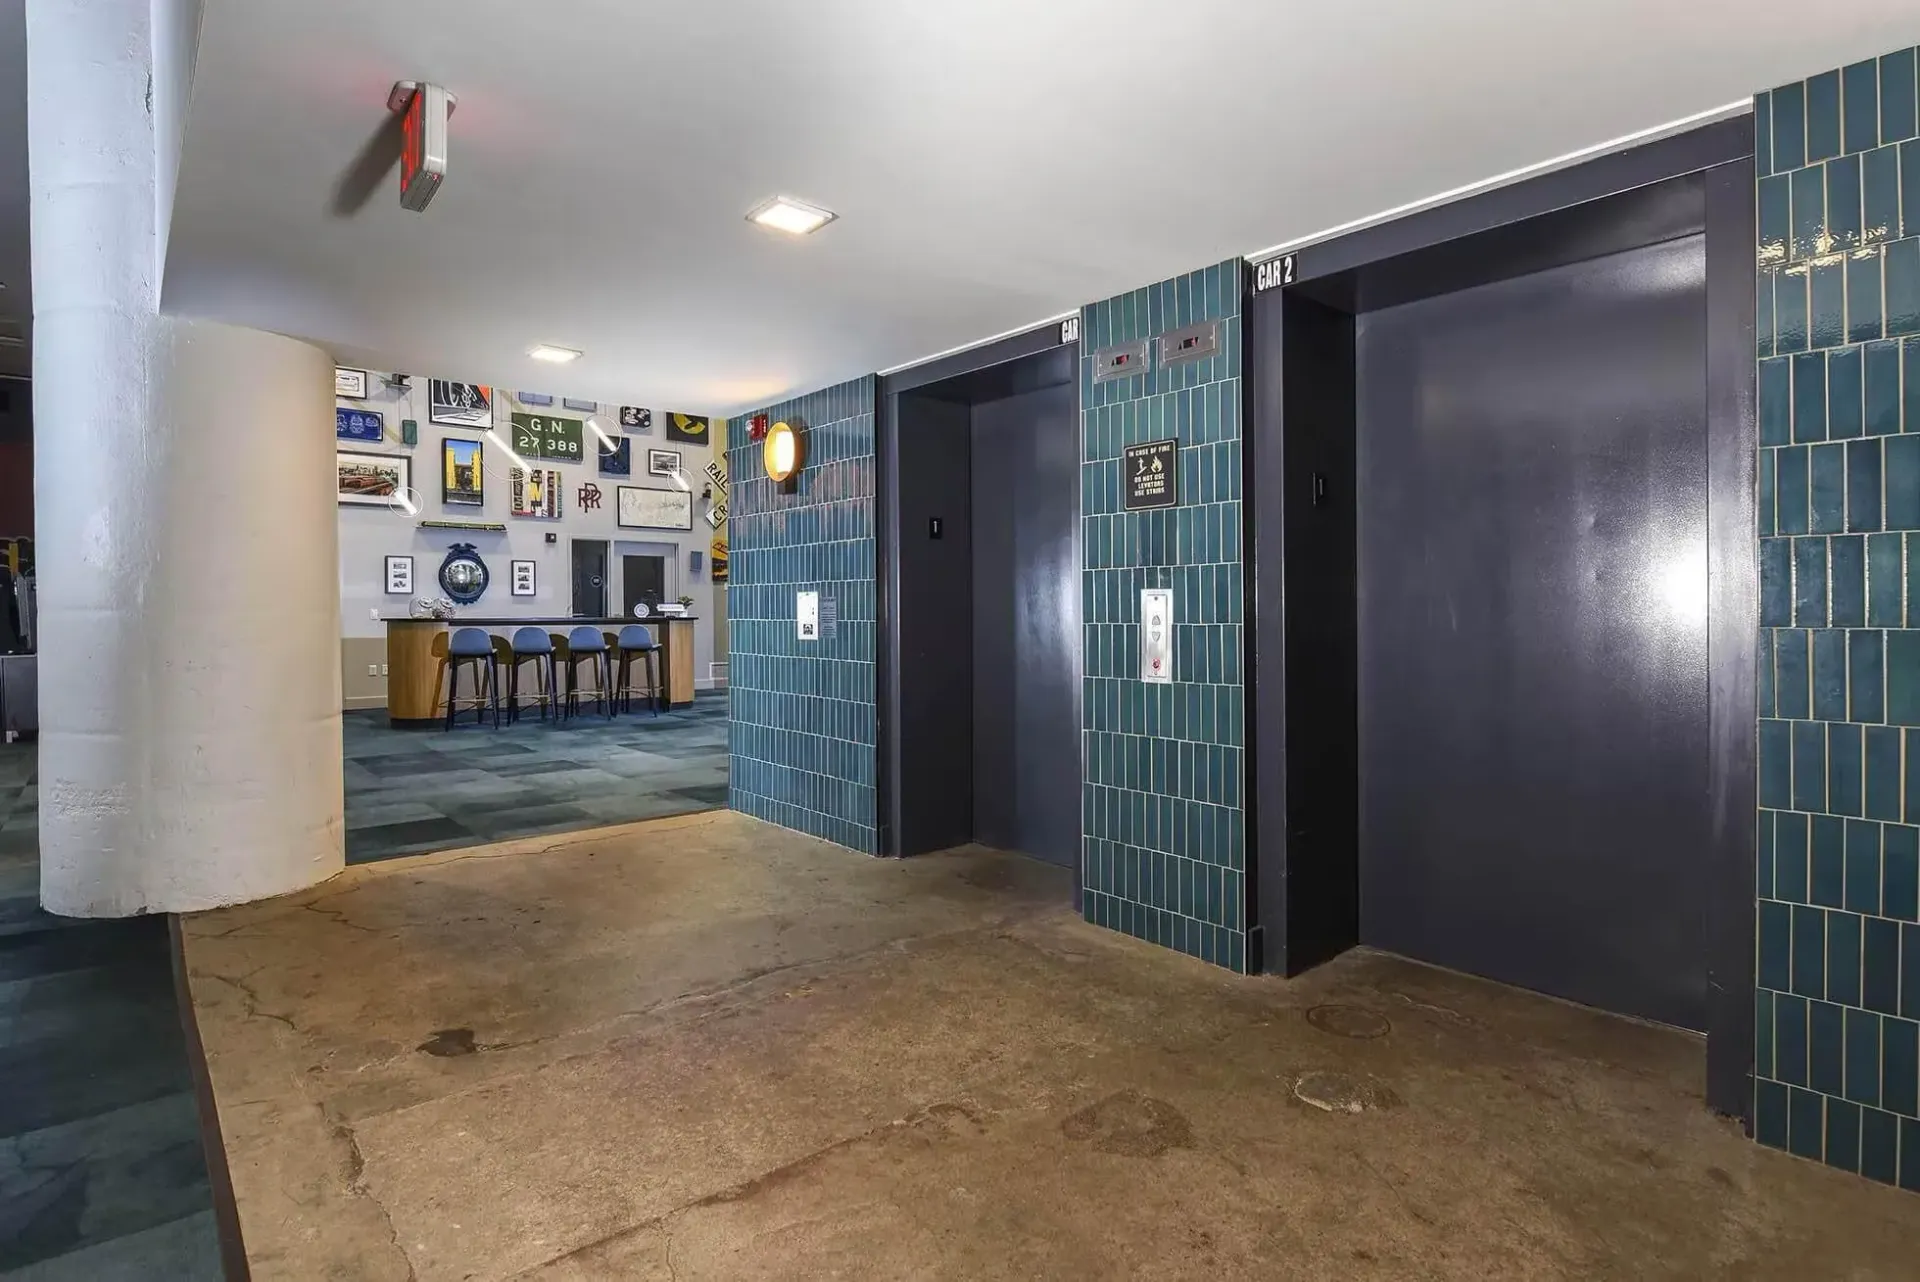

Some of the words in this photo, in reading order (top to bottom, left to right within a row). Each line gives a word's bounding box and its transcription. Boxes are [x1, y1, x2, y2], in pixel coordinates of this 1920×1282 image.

[1257, 260, 1281, 291] CAR
[1284, 256, 1292, 284] 2
[1061, 318, 1079, 343] CAR
[519, 436, 540, 448] 27
[547, 439, 578, 453] 388
[1135, 448, 1148, 457] CASE
[1150, 446, 1157, 454] OF
[1158, 444, 1170, 453] FIRE
[1142, 474, 1153, 482] NOT
[1154, 472, 1165, 480] USE
[1146, 487, 1165, 496] STAIRS
